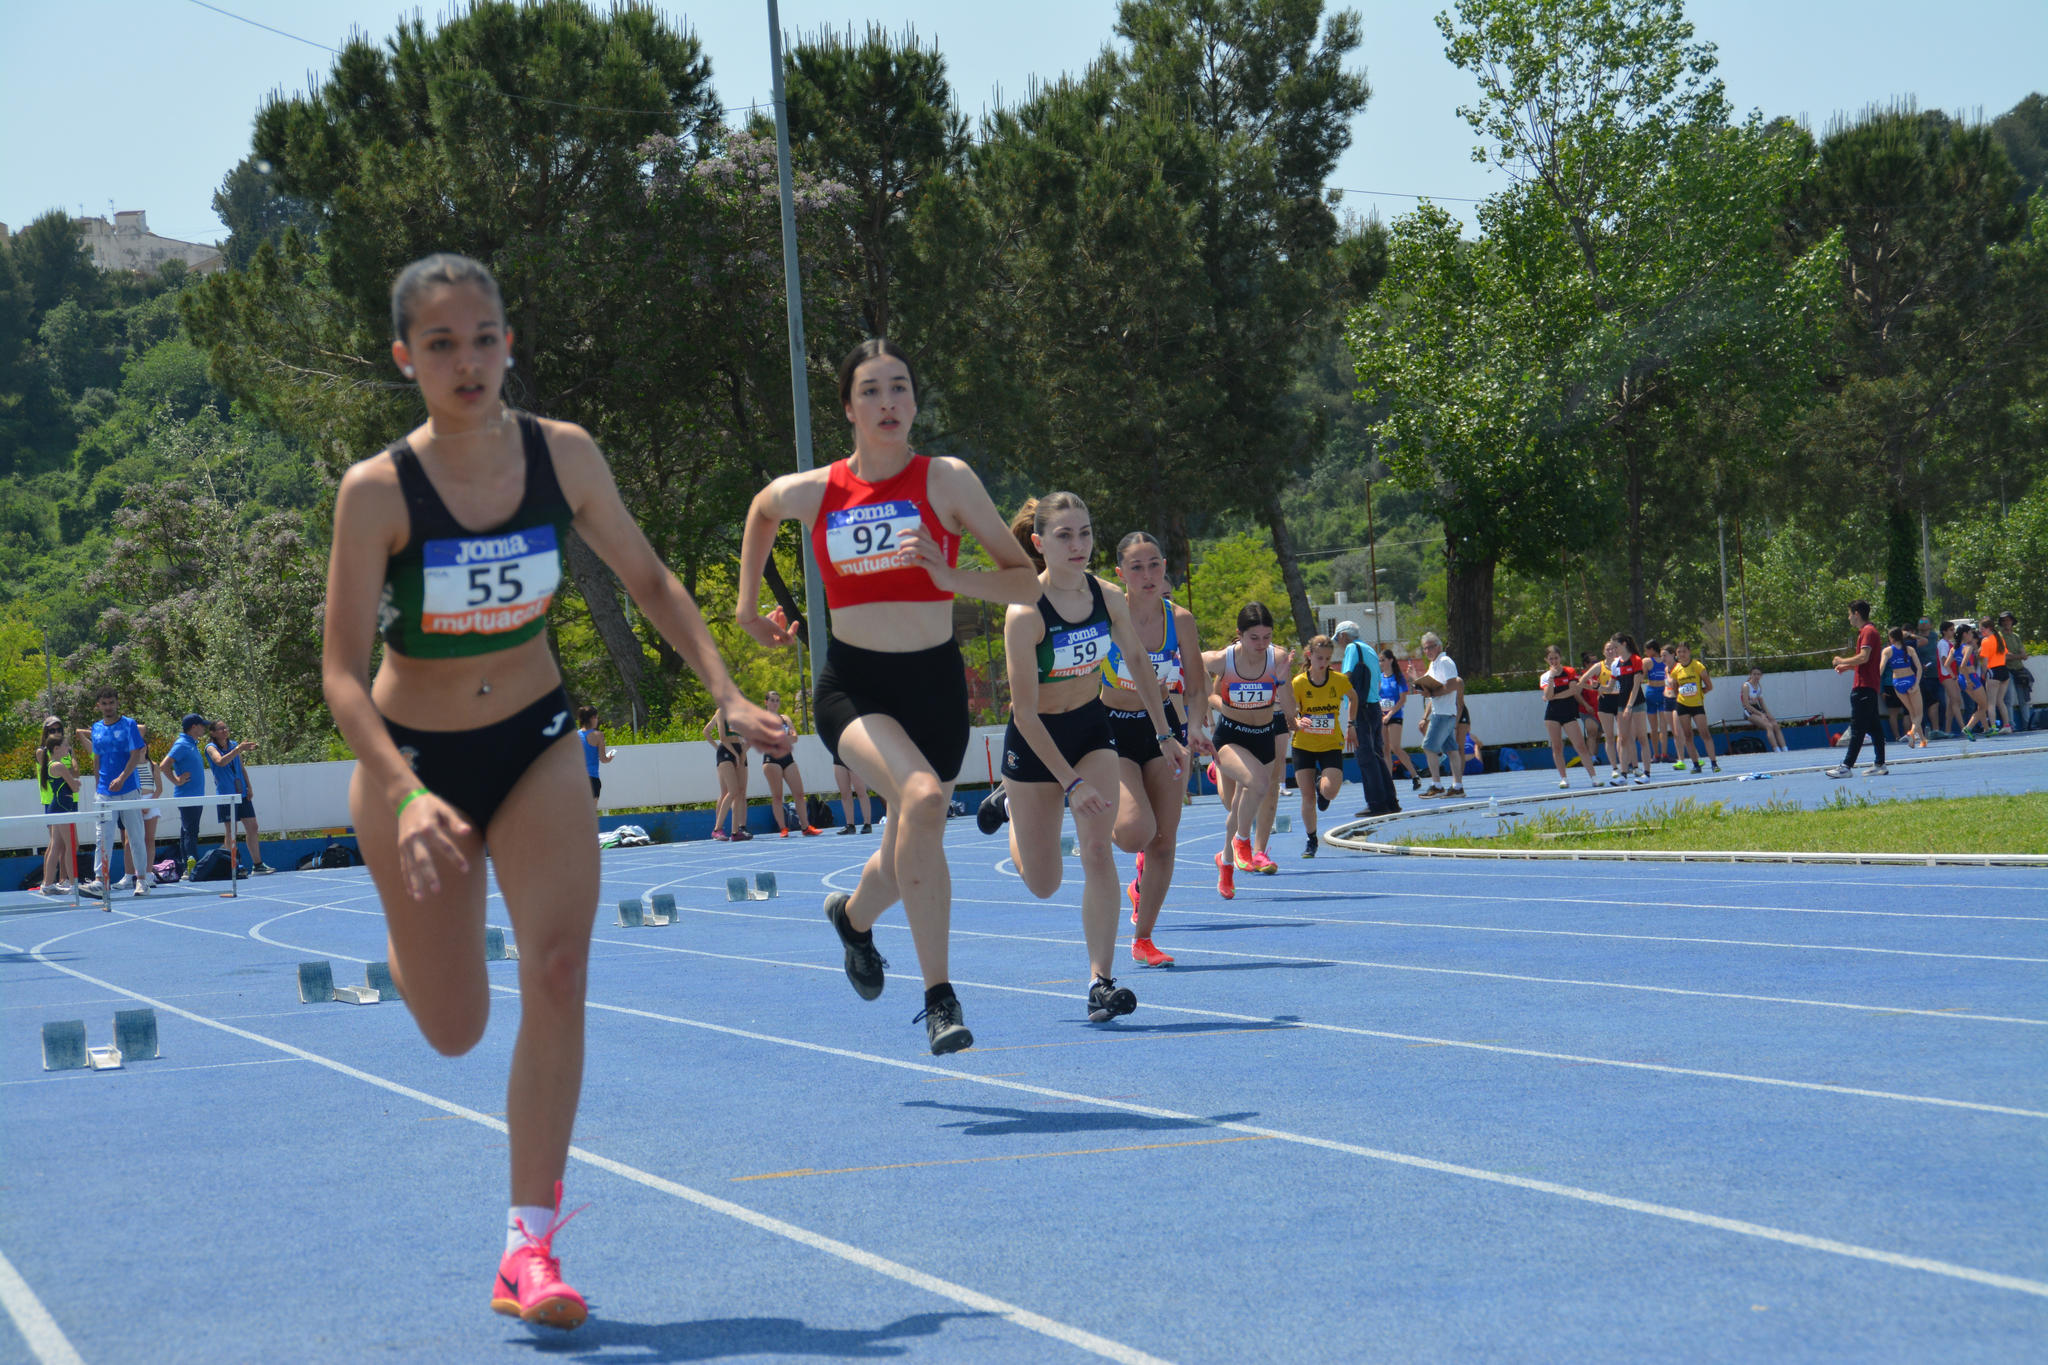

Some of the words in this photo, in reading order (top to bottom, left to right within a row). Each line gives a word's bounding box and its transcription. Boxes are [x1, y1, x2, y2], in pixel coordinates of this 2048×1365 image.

[852, 522, 895, 555] 92
[467, 563, 523, 606] 55
[1072, 641, 1097, 666] 59
[1237, 690, 1265, 702] 171
[1108, 709, 1147, 719] NIKE
[1234, 724, 1271, 734] ARMOUR
